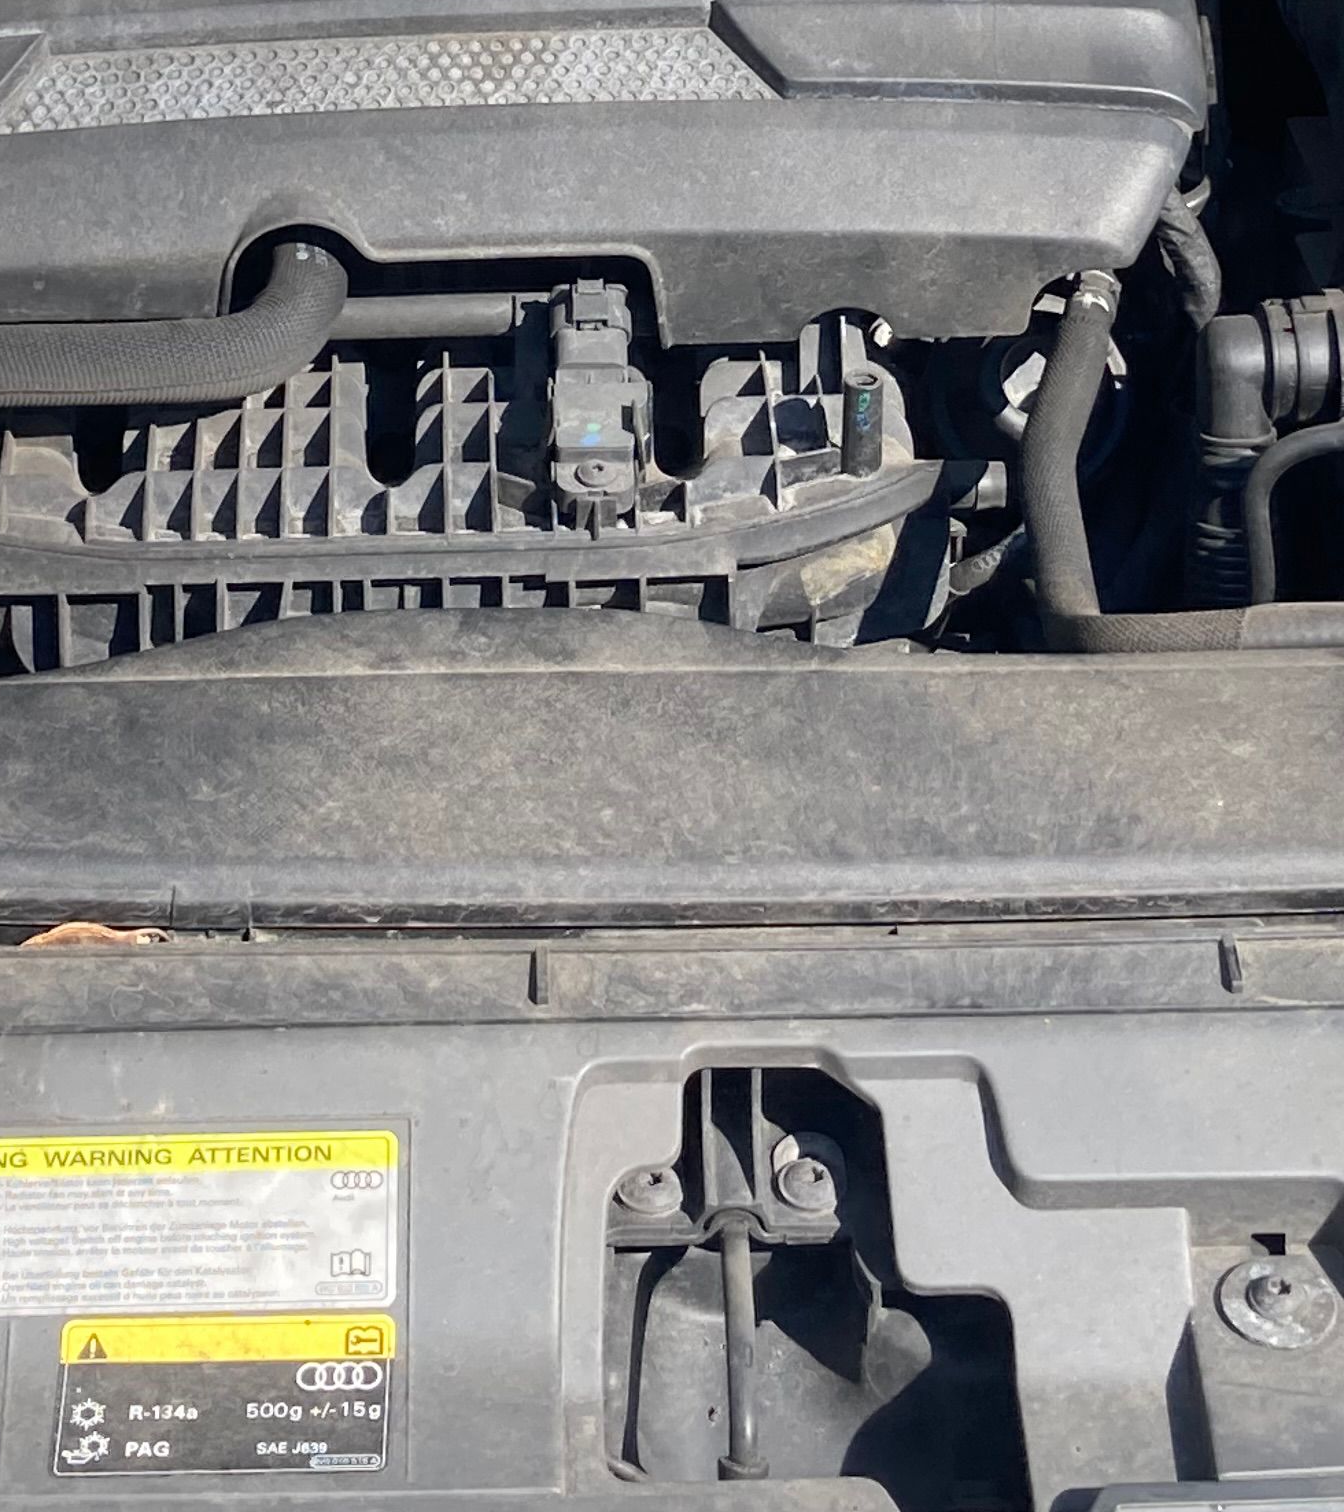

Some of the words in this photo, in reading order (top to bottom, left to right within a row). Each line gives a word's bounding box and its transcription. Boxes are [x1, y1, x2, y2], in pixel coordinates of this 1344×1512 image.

[43, 1148, 173, 1168] WARNING
[188, 1144, 333, 1164] ATTENTION
[129, 1403, 198, 1421] R-134a
[246, 1402, 303, 1422] 500g
[124, 1441, 170, 1457] PAG
[256, 1442, 287, 1455] SAE
[292, 1441, 328, 1455] J639
